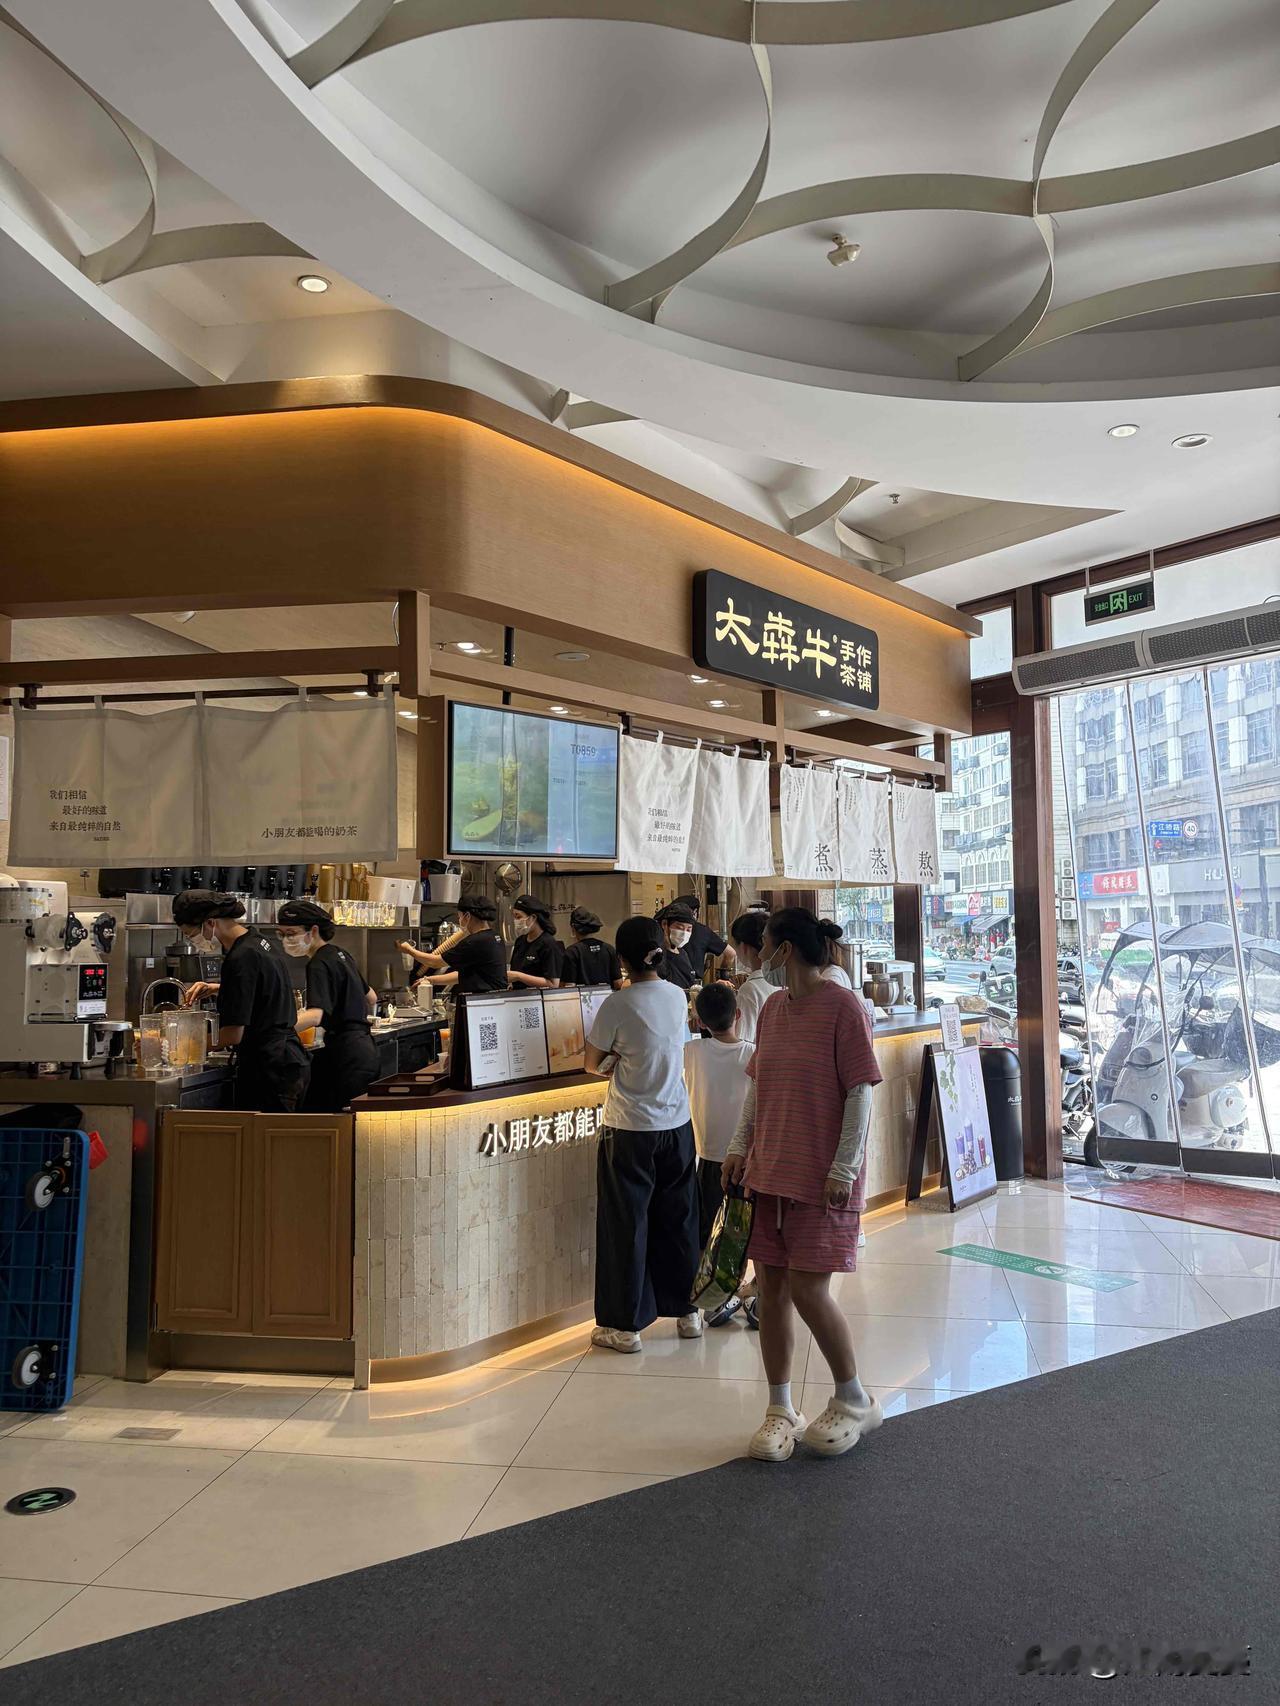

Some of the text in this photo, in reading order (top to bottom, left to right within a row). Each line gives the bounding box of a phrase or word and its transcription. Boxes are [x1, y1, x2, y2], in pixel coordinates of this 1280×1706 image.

[1128, 592, 1143, 604] EXIT
[715, 597, 838, 679] 太犇牛
[839, 639, 873, 668] 手作
[839, 663, 873, 694] 茶铺
[49, 789, 88, 801] 我们相信
[62, 804, 108, 816] 最好的味道
[49, 820, 121, 832] 来自最纯粹的自然
[260, 825, 358, 839] 小朋友都能喝的奶茶
[814, 842, 834, 872] 煮
[869, 847, 888, 876] 蒸
[918, 850, 934, 877] 熬
